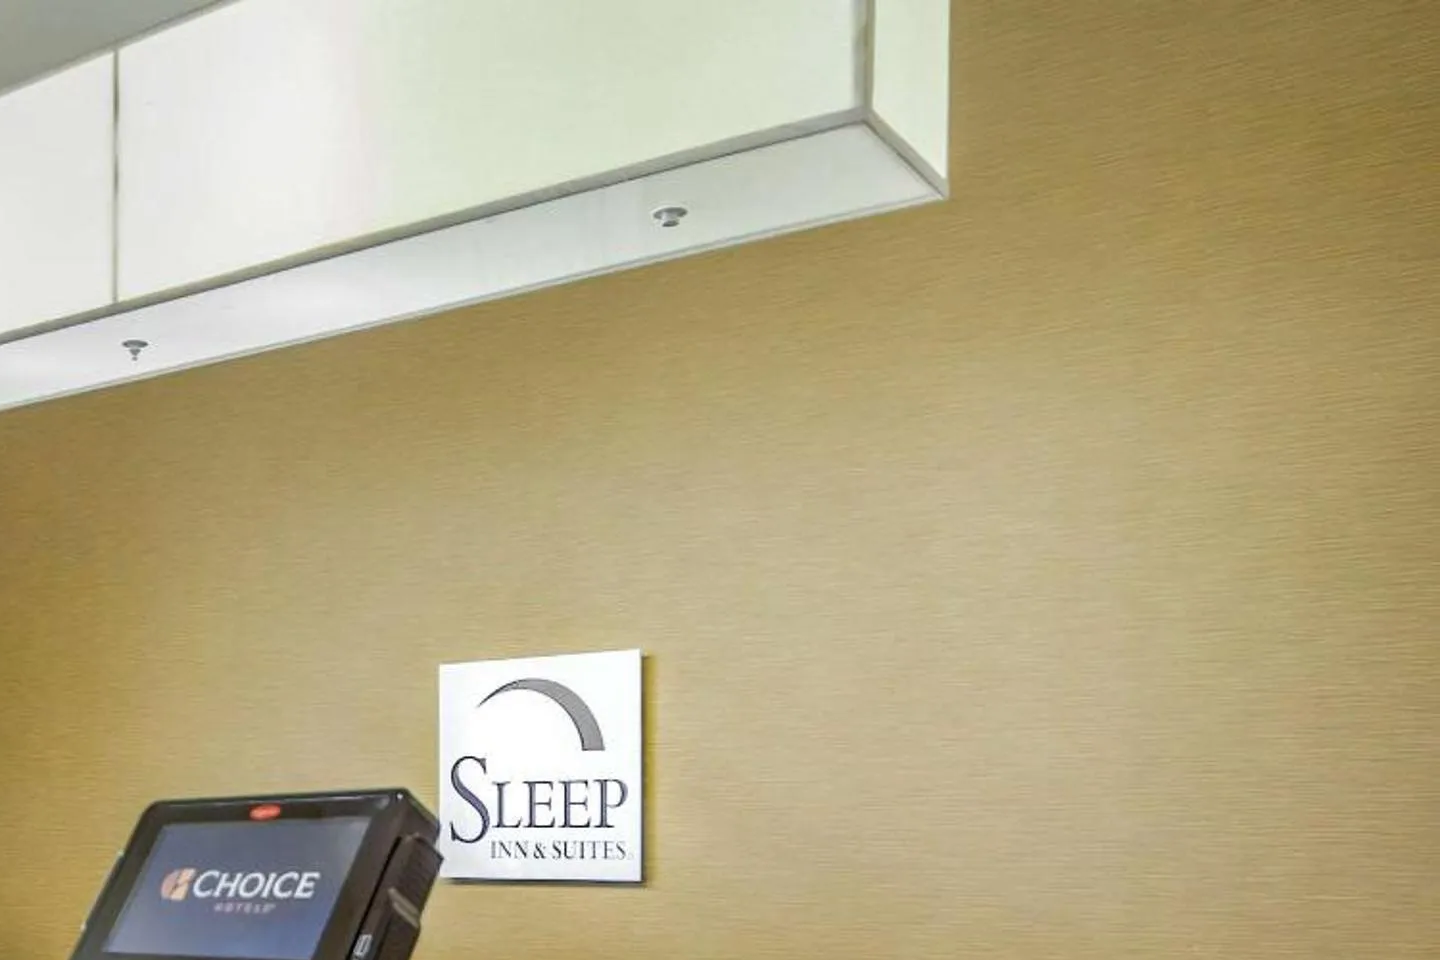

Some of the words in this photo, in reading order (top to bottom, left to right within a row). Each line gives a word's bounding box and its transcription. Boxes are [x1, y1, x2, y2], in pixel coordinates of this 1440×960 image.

[450, 756, 628, 843] SLEEP
[489, 840, 529, 860] INN
[533, 840, 546, 859] &
[551, 840, 627, 860] SUITES
[192, 869, 321, 900] CHOICE
